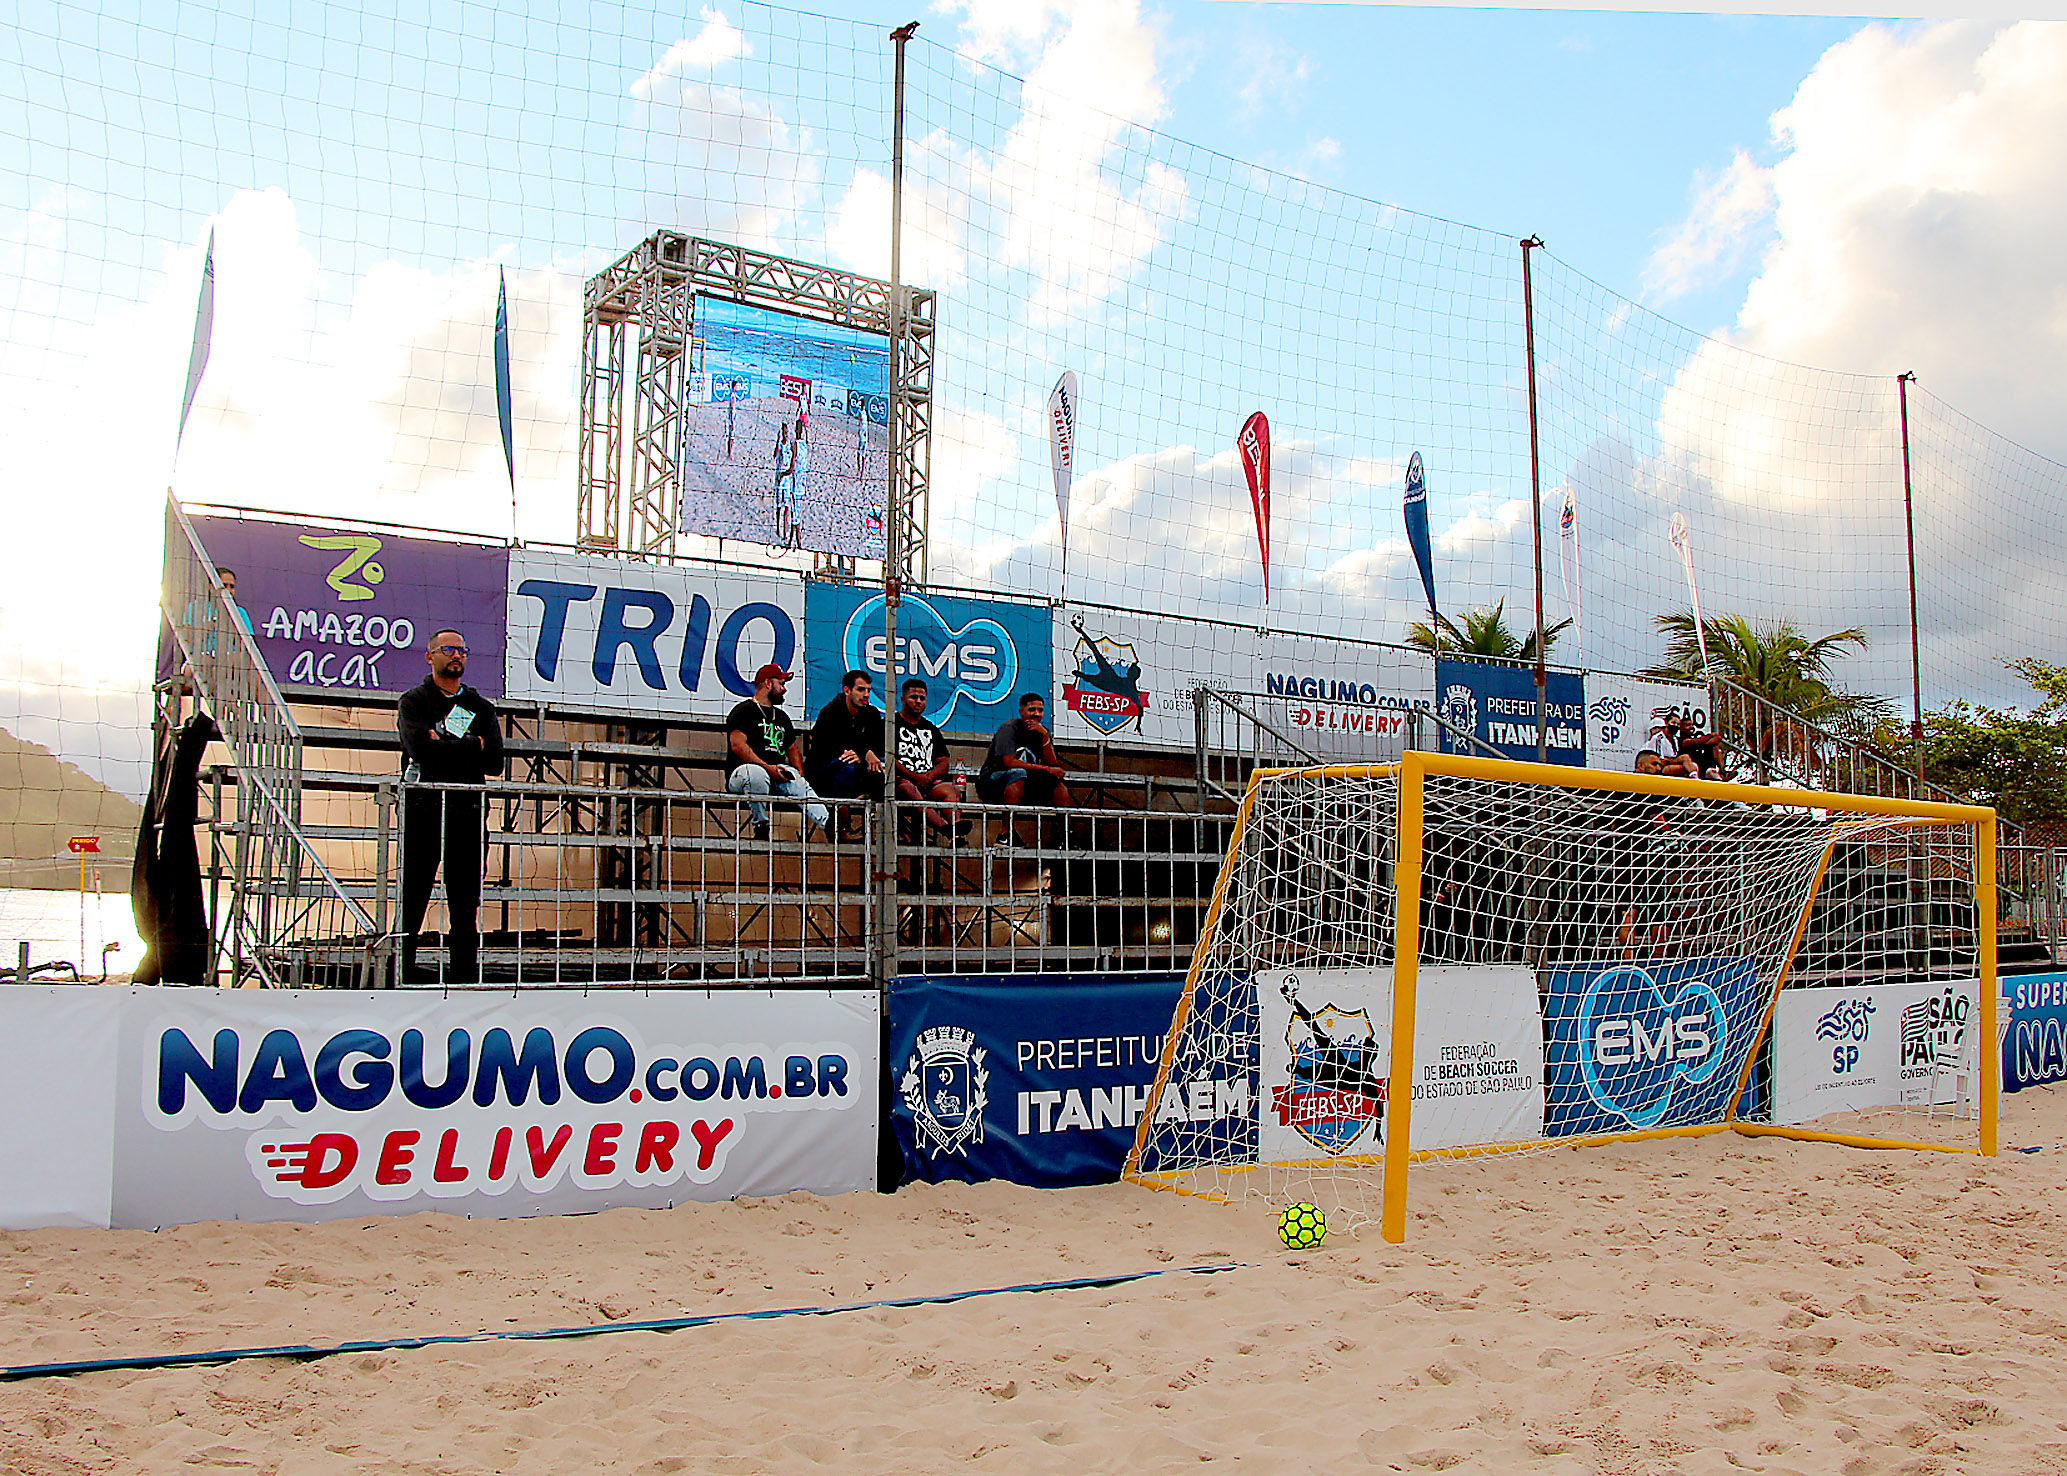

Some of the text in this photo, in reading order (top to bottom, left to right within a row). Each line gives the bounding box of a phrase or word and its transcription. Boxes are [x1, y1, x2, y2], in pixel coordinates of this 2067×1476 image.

[261, 605, 415, 649] AMAZOO
[515, 577, 797, 699] TRIO
[289, 649, 385, 688] açaí
[864, 635, 999, 682] EMS
[1080, 693, 1131, 713] FEBS-SP
[1487, 696, 1582, 719] PREFEITRA DE
[1290, 708, 1402, 734] DELIVERY
[1601, 726, 1621, 744] SP
[1929, 987, 1970, 1029] SÃO
[1211, 1030, 1250, 1060] DE
[1441, 1041, 1496, 1061] FEDERAÇÃO
[1595, 1014, 1711, 1066] EMS
[2015, 1018, 2067, 1082] NA
[158, 1025, 849, 1115] NAGUMO.COM.BR
[1424, 1060, 1518, 1080] DE BEACH SOCCER
[1832, 1045, 1859, 1074] SP
[1017, 1069, 1250, 1135] ITANHAÉM
[1426, 1081, 1463, 1099] ESTADO
[1465, 1080, 1478, 1096] DE
[1480, 1077, 1501, 1094] SÃO
[1502, 1075, 1532, 1092] PAULO
[1299, 1094, 1363, 1120] FEBS-SP
[262, 1118, 734, 1190] DELIVERY
